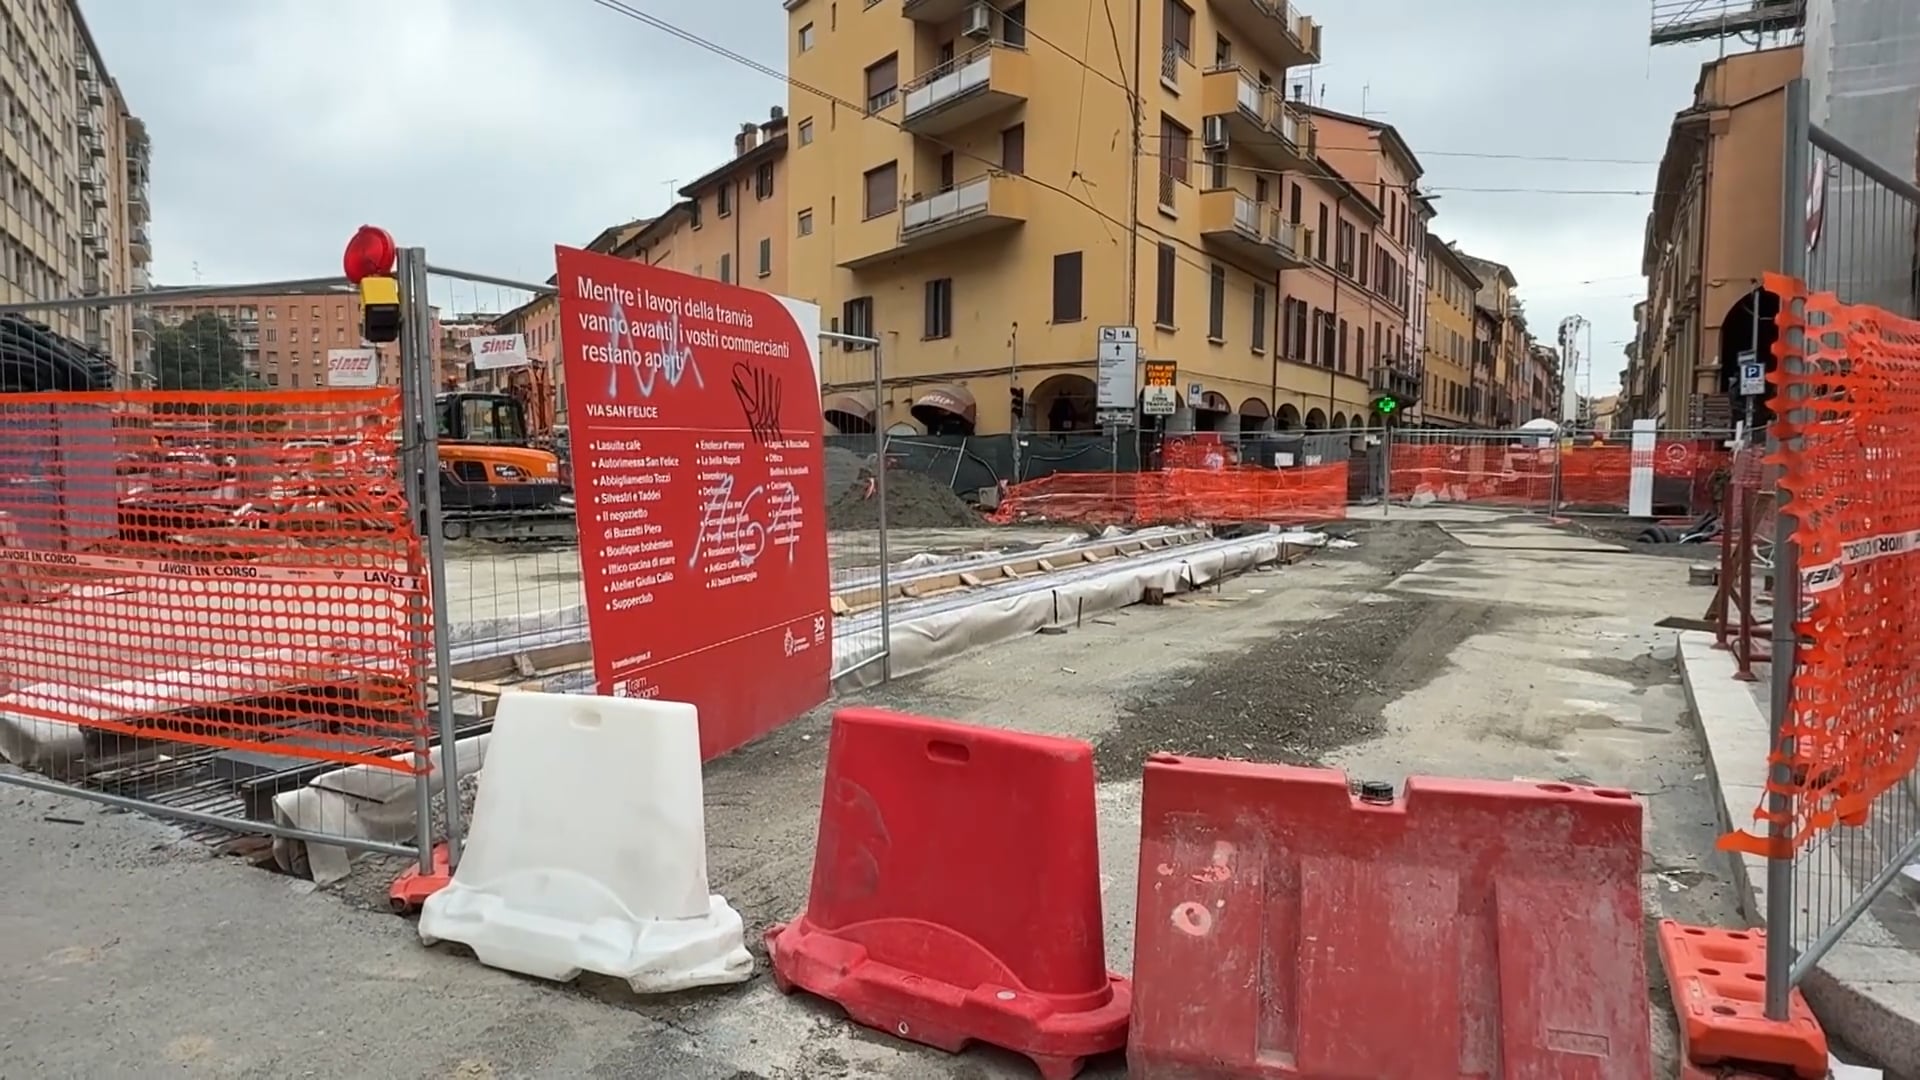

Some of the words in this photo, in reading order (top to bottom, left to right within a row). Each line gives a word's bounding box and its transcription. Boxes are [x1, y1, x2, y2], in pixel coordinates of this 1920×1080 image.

[577, 275, 634, 307] Mentre
[637, 287, 642, 308] i
[645, 289, 682, 315] lavori
[685, 298, 714, 321] della
[716, 304, 753, 328] tranvia
[579, 312, 628, 335] vanno
[631, 320, 672, 340] avanti
[679, 323, 684, 343] i
[685, 328, 719, 348] vostri
[721, 334, 789, 358] commercianti
[582, 343, 642, 366] restano
[645, 351, 684, 372] aperti
[586, 404, 605, 416] VIA
[606, 405, 626, 417] SAN
[627, 406, 658, 418] FELICE
[598, 458, 645, 468] Autorimessa
[645, 457, 659, 466] San
[659, 457, 679, 466] Felice
[600, 475, 653, 487] Abbigliamento
[609, 509, 648, 522] negozietto
[606, 544, 640, 556] Boutique
[31, 551, 42, 561] IN
[44, 553, 77, 564] CORSO
[628, 559, 651, 571] cucina
[659, 556, 676, 565] mare
[158, 563, 191, 575] LAVORI
[195, 567, 210, 576] IN
[214, 567, 257, 578] CORSO
[610, 579, 635, 592] Atelier
[611, 593, 654, 610] Supperclub
[627, 677, 647, 691] Tram
